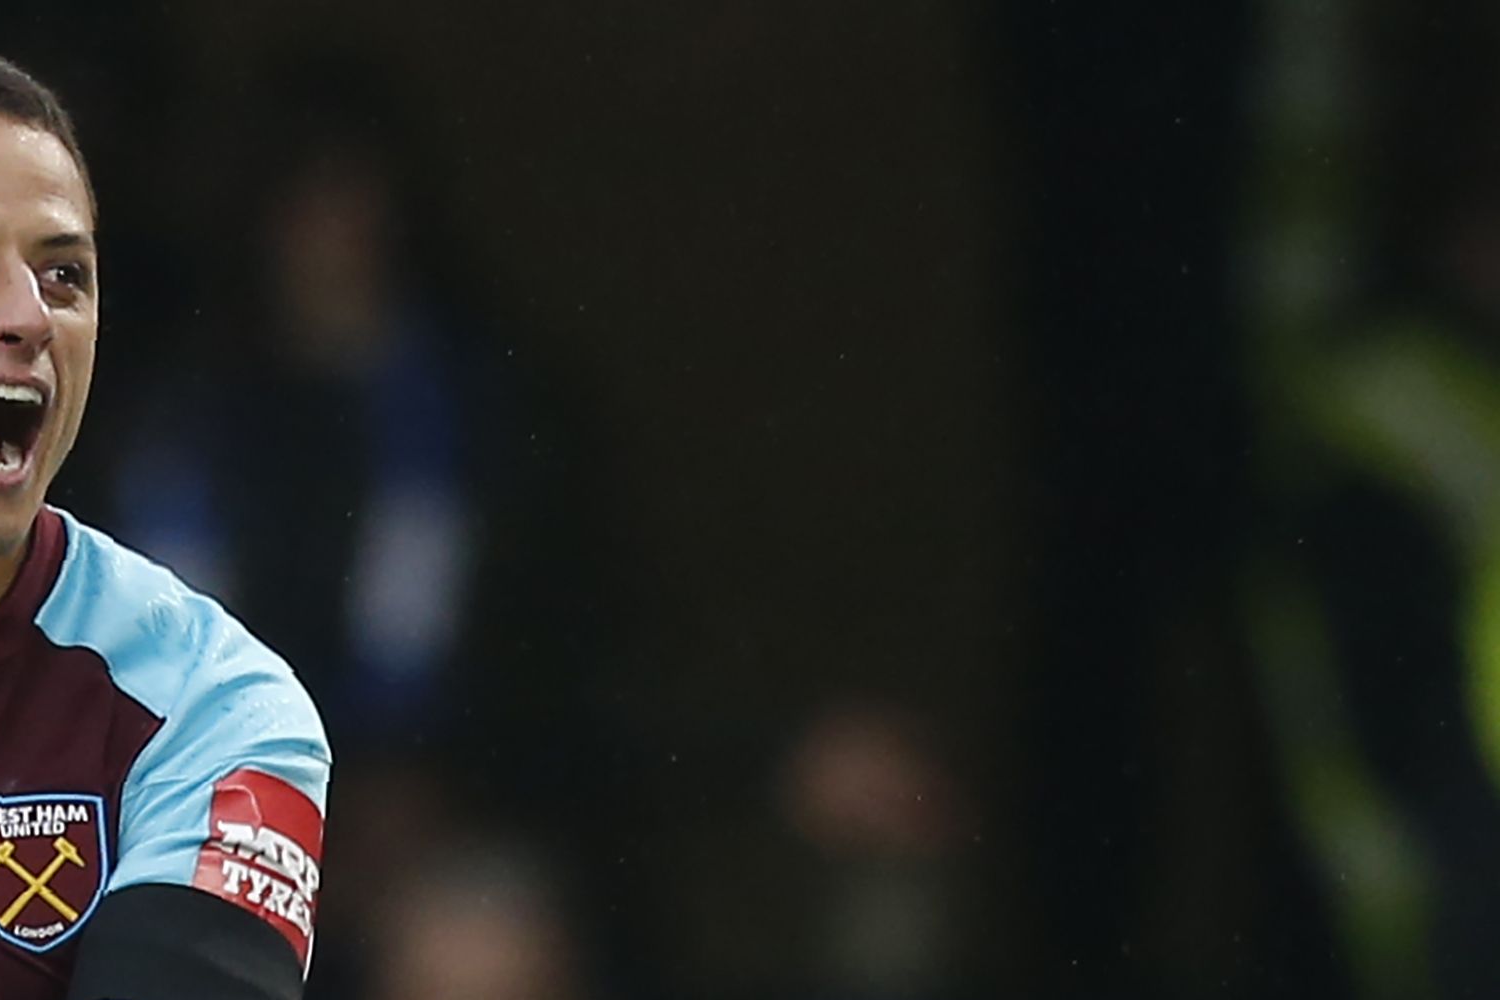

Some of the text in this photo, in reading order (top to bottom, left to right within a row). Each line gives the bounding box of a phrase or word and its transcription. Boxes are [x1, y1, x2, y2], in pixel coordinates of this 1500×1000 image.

[35, 804, 88, 822] HAM
[0, 821, 65, 838] UNITED
[13, 922, 64, 938] LONDON
